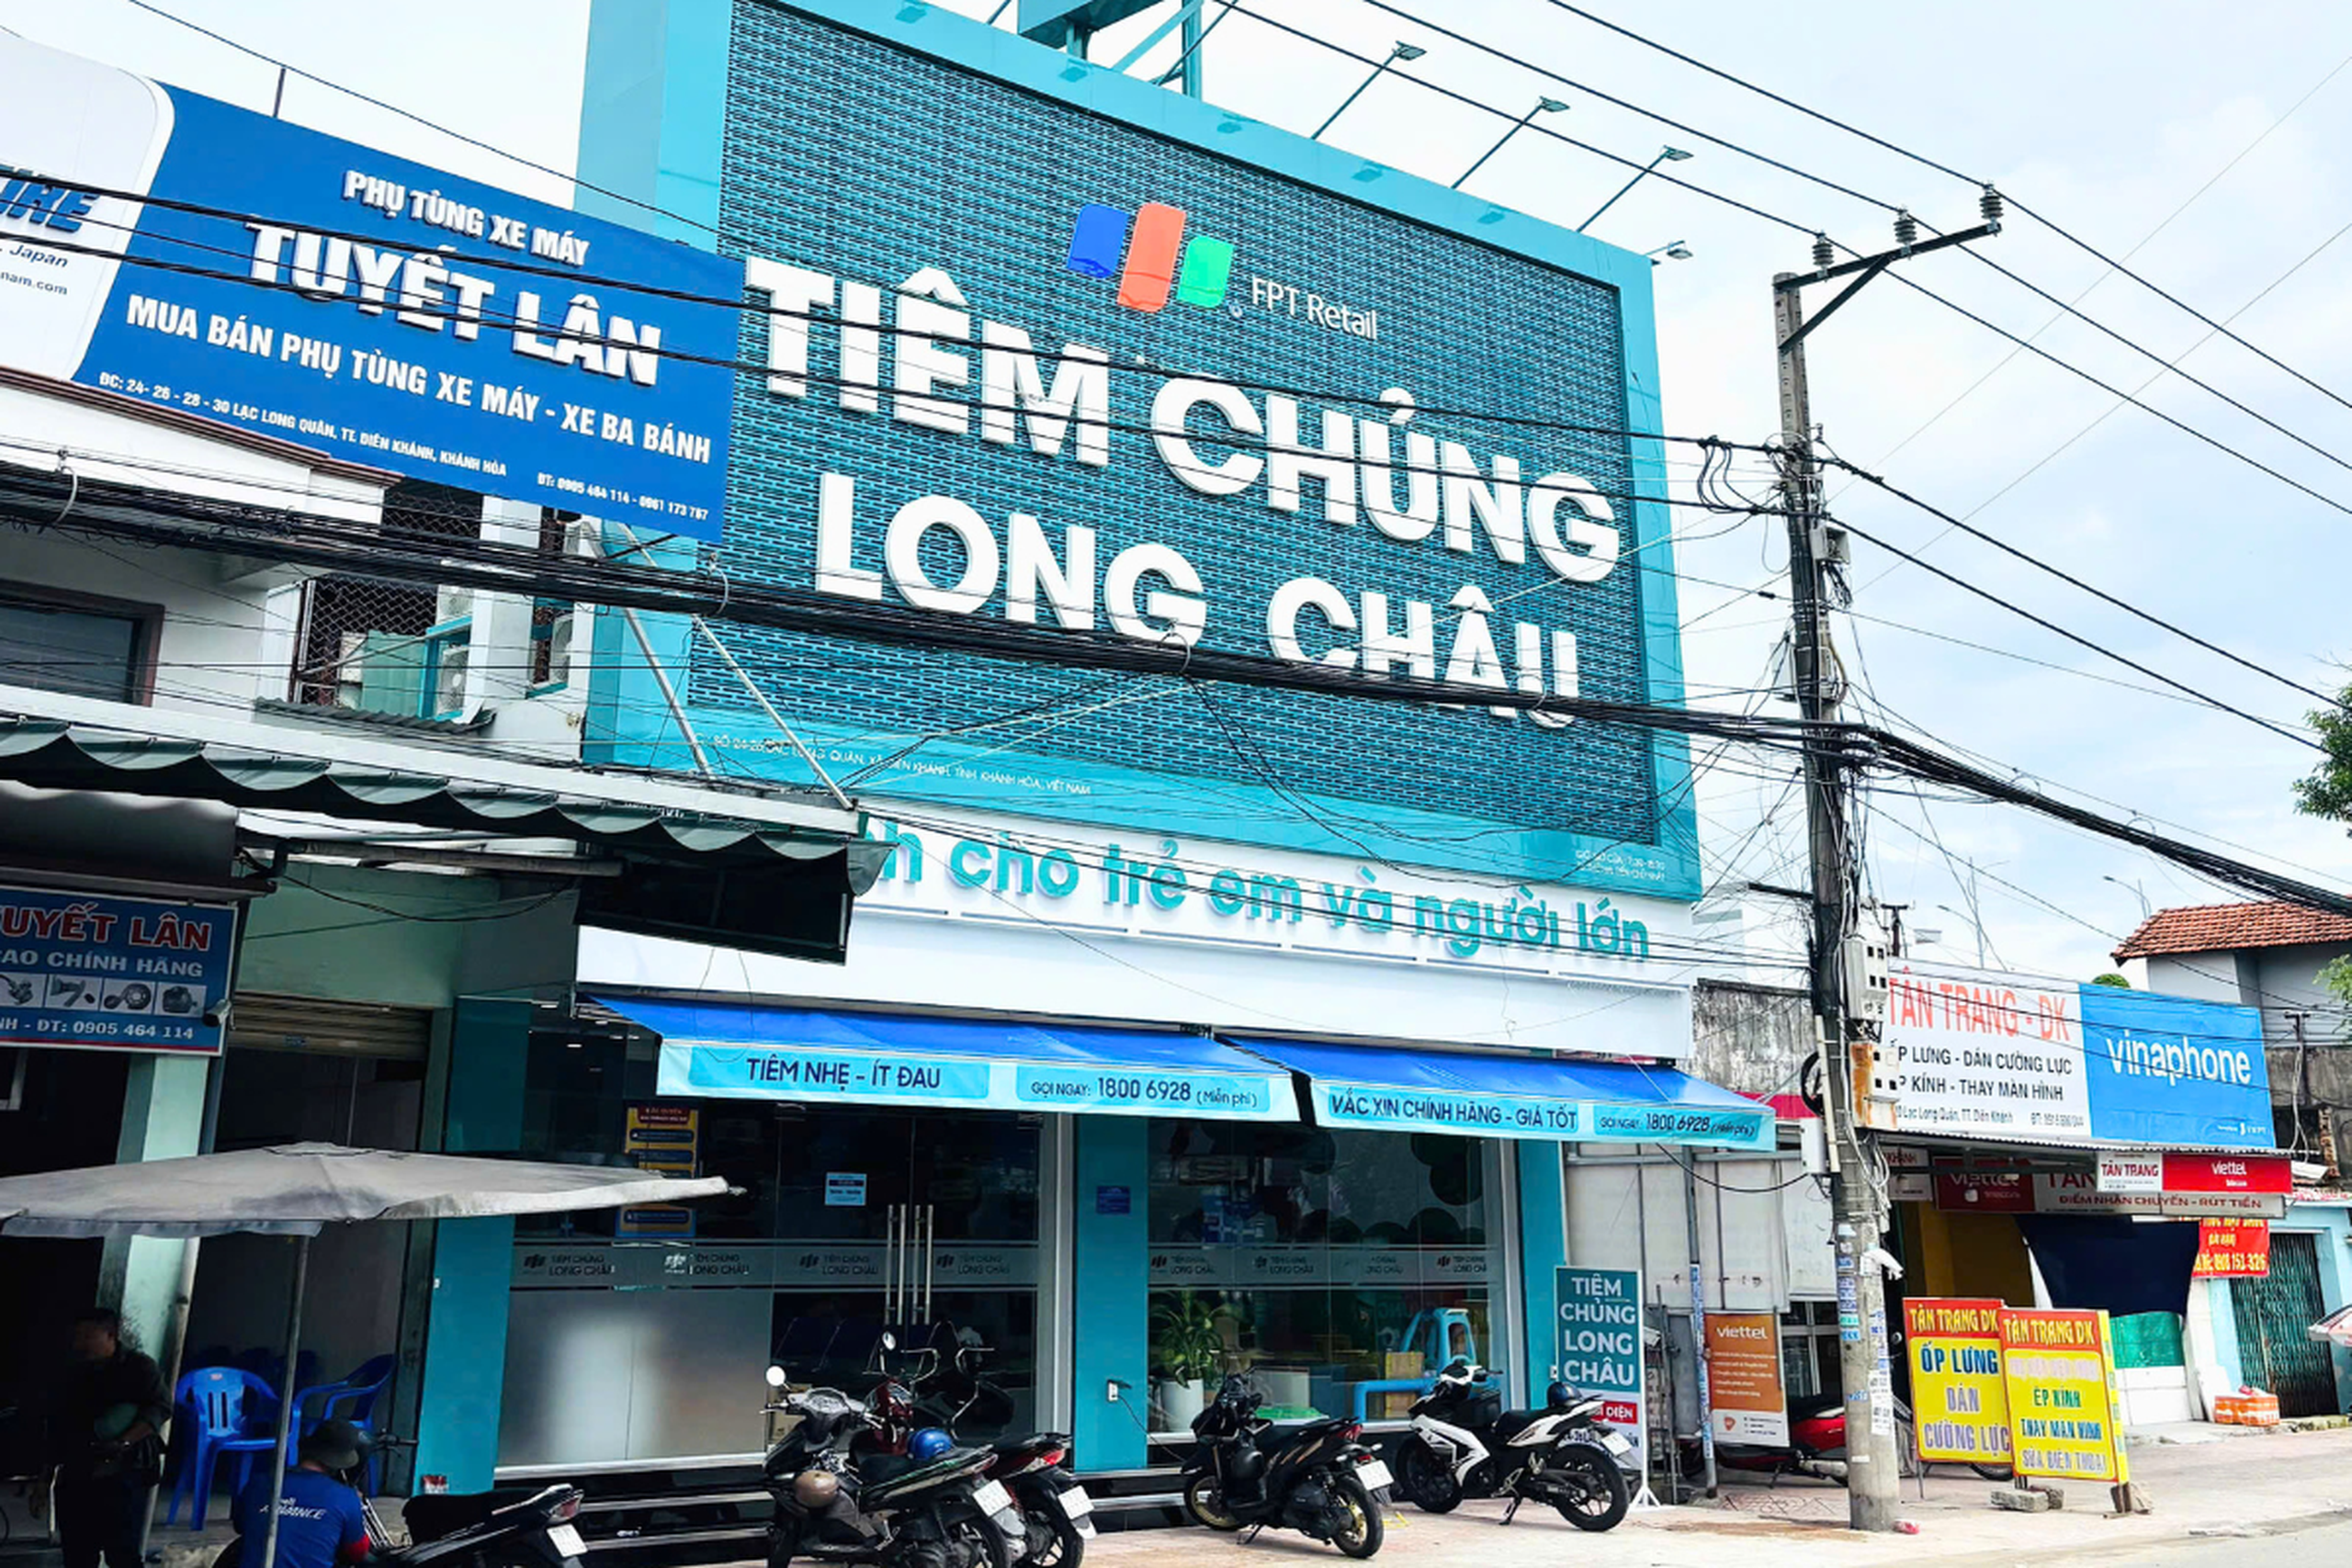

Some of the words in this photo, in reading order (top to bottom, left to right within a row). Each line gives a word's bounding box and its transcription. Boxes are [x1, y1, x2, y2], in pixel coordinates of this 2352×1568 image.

[344, 170, 404, 219] PHỤ
[410, 189, 484, 237] TÙNG
[489, 215, 526, 249] XE
[531, 230, 590, 266] MÁY
[9, 244, 68, 267] Japan
[245, 213, 494, 341] TUYẾT
[513, 294, 661, 386] LÂN
[1252, 276, 1300, 316] FPT
[1306, 292, 1378, 341] Retail
[745, 255, 1108, 468] TIÊM
[127, 295, 198, 340] MUA
[207, 315, 273, 358] BÁN
[280, 333, 341, 378] PHỤ
[351, 350, 427, 396] TÙNG
[435, 372, 473, 407] XE
[481, 383, 540, 423] MÁY
[560, 403, 595, 436] XE
[601, 412, 634, 446] BA
[643, 423, 711, 464] BÁNH
[183, 392, 200, 407] 28
[212, 399, 230, 414] 30
[232, 402, 258, 422] LẠC
[262, 409, 295, 430] LONG
[440, 449, 480, 471] KHÁNH
[482, 459, 507, 477] HÒA
[1150, 373, 1621, 583] CHỦNG
[610, 490, 629, 504] 114
[668, 502, 687, 516] 173
[815, 471, 1207, 649] LONG
[1266, 577, 1580, 728] CHÂU
[1066, 783, 1091, 795] NAM
[949, 830, 1080, 898] cho
[1102, 840, 1187, 910] trẻ
[1207, 869, 1303, 922] em
[1319, 865, 1393, 934] và
[1413, 885, 1560, 958] người
[1573, 897, 1649, 963] lớn
[0, 902, 118, 942] UYẾT
[129, 911, 212, 952] LÂN
[0, 949, 39, 964] AO
[47, 951, 128, 972] CHÍNH
[136, 958, 204, 978] HÃNG
[1889, 965, 1933, 1029] TÂN
[1939, 982, 2019, 1038] TRANG
[2039, 994, 2071, 1042] DK
[73, 1021, 119, 1036] 0905
[122, 1023, 156, 1038] 464
[162, 1026, 194, 1040] 114
[746, 1054, 799, 1082] TIÊM
[804, 1061, 850, 1092] NHẸ
[872, 1058, 891, 1088] ÍT
[897, 1066, 942, 1089] ĐAU
[1912, 1045, 1951, 1066] LƯNG
[1963, 1047, 1992, 1068] DÁN
[1996, 1051, 2043, 1073] CƯỜNG
[2047, 1057, 2073, 1077] LỰC
[2106, 1029, 2251, 1087] vinaphone
[1056, 1082, 1091, 1098] NGAY:
[1098, 1077, 1141, 1100] 1800
[1145, 1079, 1192, 1101] 6928
[1912, 1072, 1947, 1093] KÍNH
[1960, 1078, 1995, 1097] THAY
[1998, 1078, 2029, 1099] MÀN
[2031, 1080, 2064, 1101] HÌNH
[1331, 1088, 1369, 1115] VẮC
[1373, 1099, 1399, 1118] XIN
[1403, 1097, 1452, 1121] CHÍNH
[1455, 1100, 1501, 1123] HÃNG
[1516, 1105, 1544, 1127] GIÁ
[1548, 1104, 1577, 1129] TỐT
[1645, 1112, 1675, 1131] 1800
[1677, 1115, 1710, 1132] 6928
[2101, 1159, 2123, 1177] TÂN
[2124, 1163, 2159, 1178] TRANG
[2211, 1160, 2247, 1177] viettel
[2134, 1193, 2188, 1208] CHUYỂN
[1571, 1273, 1623, 1297] TIÊM
[1560, 1297, 1635, 1325] CHỦNG
[1909, 1303, 1935, 1332] TÂN
[1936, 1308, 1979, 1334] TRANG
[1565, 1329, 1634, 1355] LONG
[1716, 1324, 1769, 1341] viettel
[2003, 1314, 2030, 1345] TÂN
[2030, 1319, 2075, 1348] TRANG
[1564, 1356, 1634, 1386] CHÂU
[1920, 1340, 1946, 1374] ỐP
[1951, 1345, 1999, 1375] LƯNG
[1946, 1382, 1981, 1414] DÁN
[1924, 1418, 1975, 1451] CƯỜNG
[1981, 1422, 2010, 1458] LỰC
